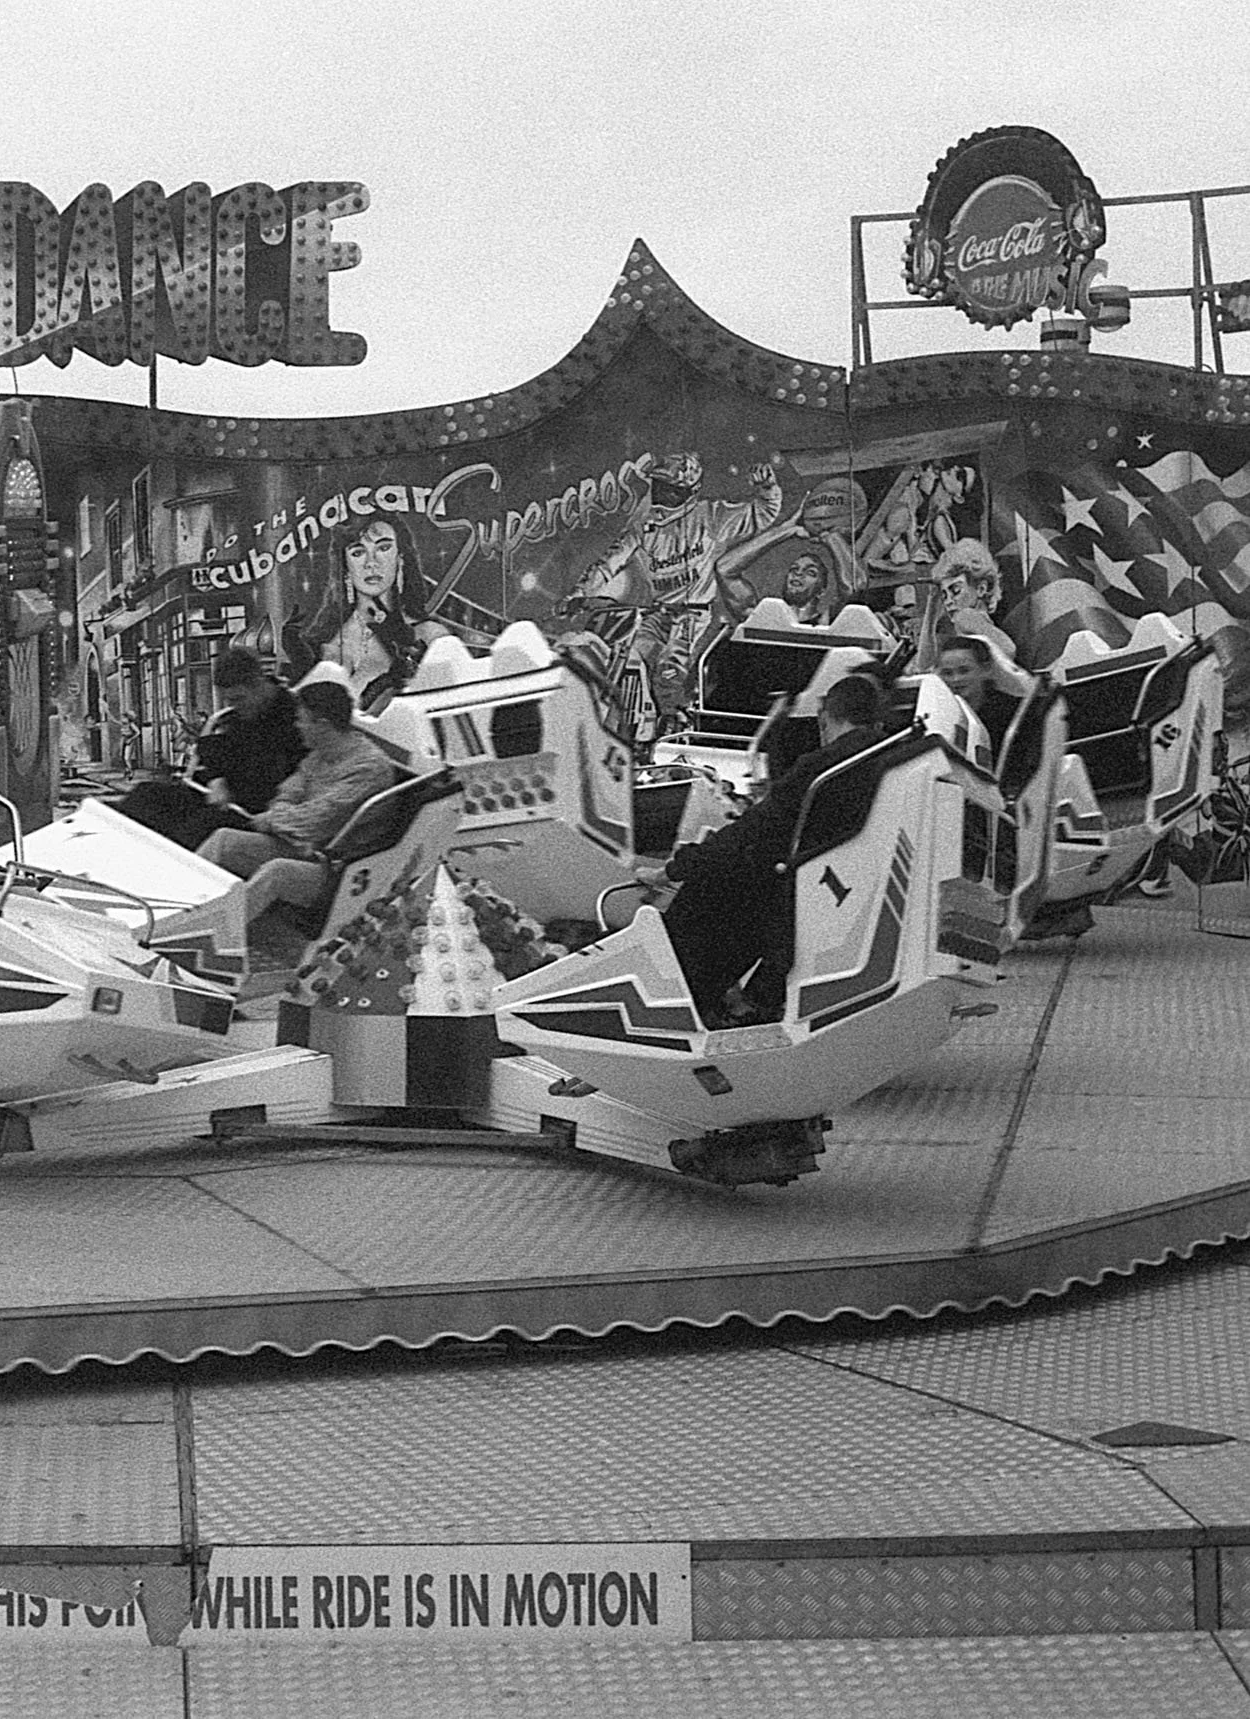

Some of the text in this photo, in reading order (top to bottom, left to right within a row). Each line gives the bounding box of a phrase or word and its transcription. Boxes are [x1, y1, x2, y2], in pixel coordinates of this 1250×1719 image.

[957, 216, 1048, 272] Coca-Cola
[1010, 257, 1109, 321] MUSIC
[206, 496, 307, 564] DO THE
[818, 865, 852, 908] 1
[192, 1576, 299, 1630] WHILE
[312, 1574, 392, 1630] RIDE
[403, 1573, 437, 1629] IS
[449, 1573, 491, 1628] IN
[502, 1571, 659, 1629] MOTION
